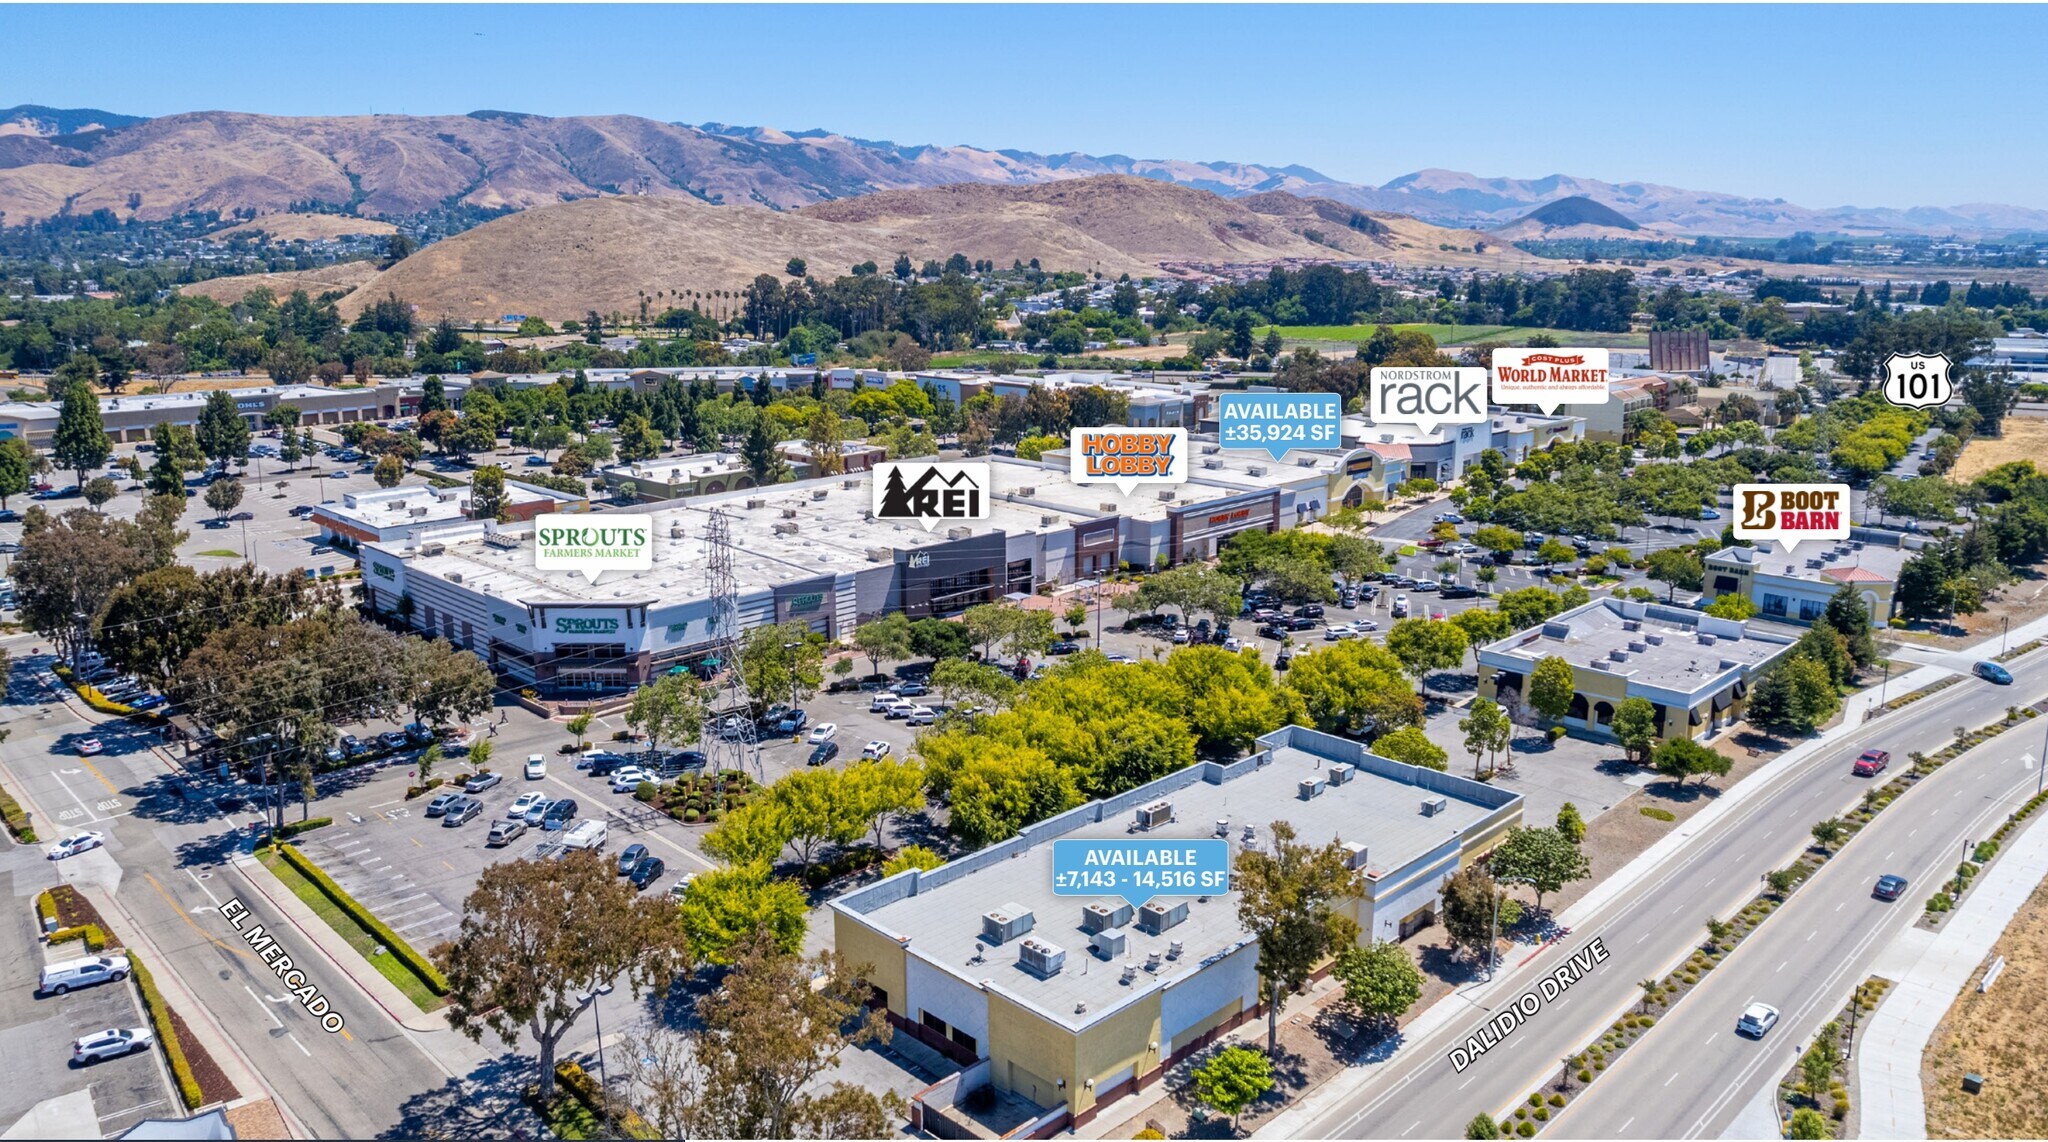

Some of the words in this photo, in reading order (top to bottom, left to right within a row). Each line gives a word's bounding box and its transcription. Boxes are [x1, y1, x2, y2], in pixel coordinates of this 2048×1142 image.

[555, 617, 619, 634] SPROUTS
[97, 798, 122, 811] STOP
[59, 807, 84, 820] STOP
